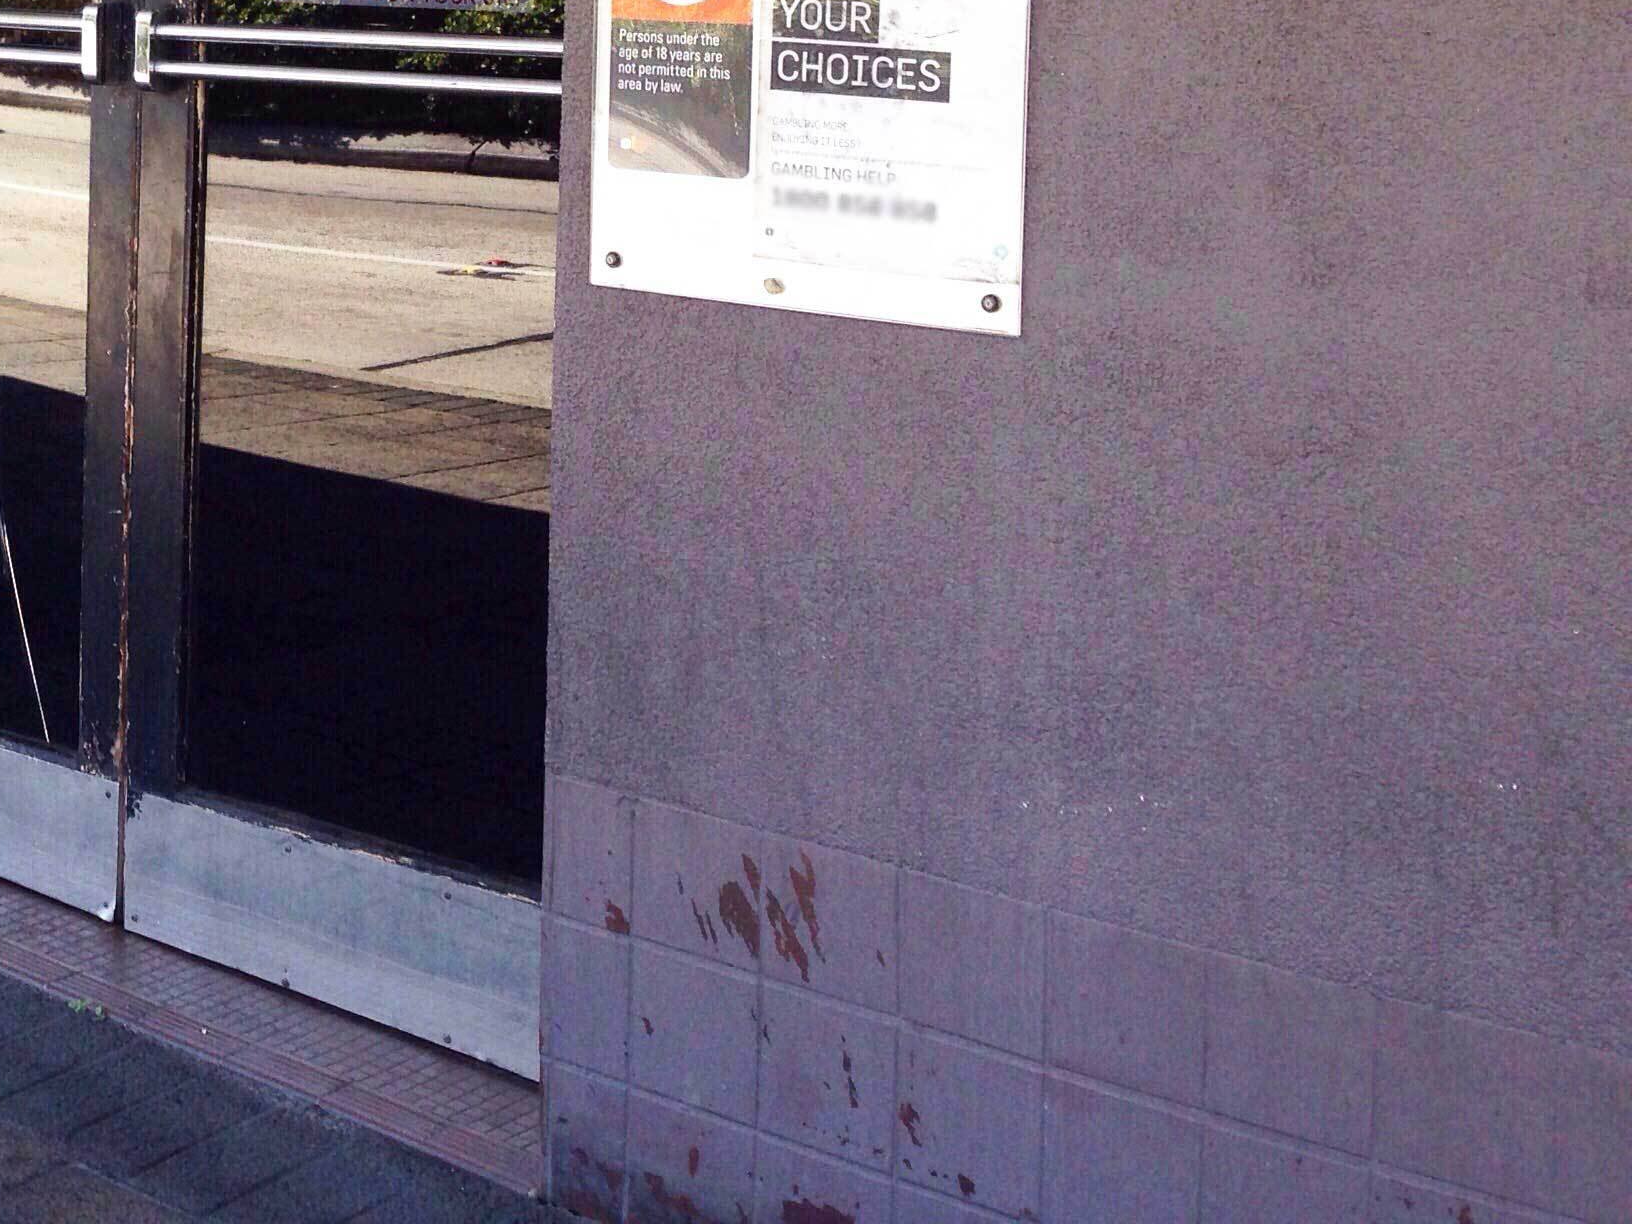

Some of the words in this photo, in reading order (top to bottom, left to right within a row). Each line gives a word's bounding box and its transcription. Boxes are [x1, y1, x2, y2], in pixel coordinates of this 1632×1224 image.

[619, 28, 664, 45] Persons
[666, 31, 699, 45] under
[701, 33, 720, 47] the
[618, 47, 639, 61] age
[641, 45, 654, 59] of
[655, 46, 668, 60] 18
[669, 50, 702, 63] years
[703, 52, 723, 63] are
[618, 62, 636, 74] not
[638, 63, 694, 78] permitted
[696, 65, 708, 78] in
[709, 65, 731, 80] this
[776, 49, 942, 92] CHOICES
[618, 78, 642, 91] area
[644, 78, 658, 94] by
[660, 79, 685, 94] law.
[770, 160, 853, 183] GAMBLING
[856, 170, 897, 185] HELP
